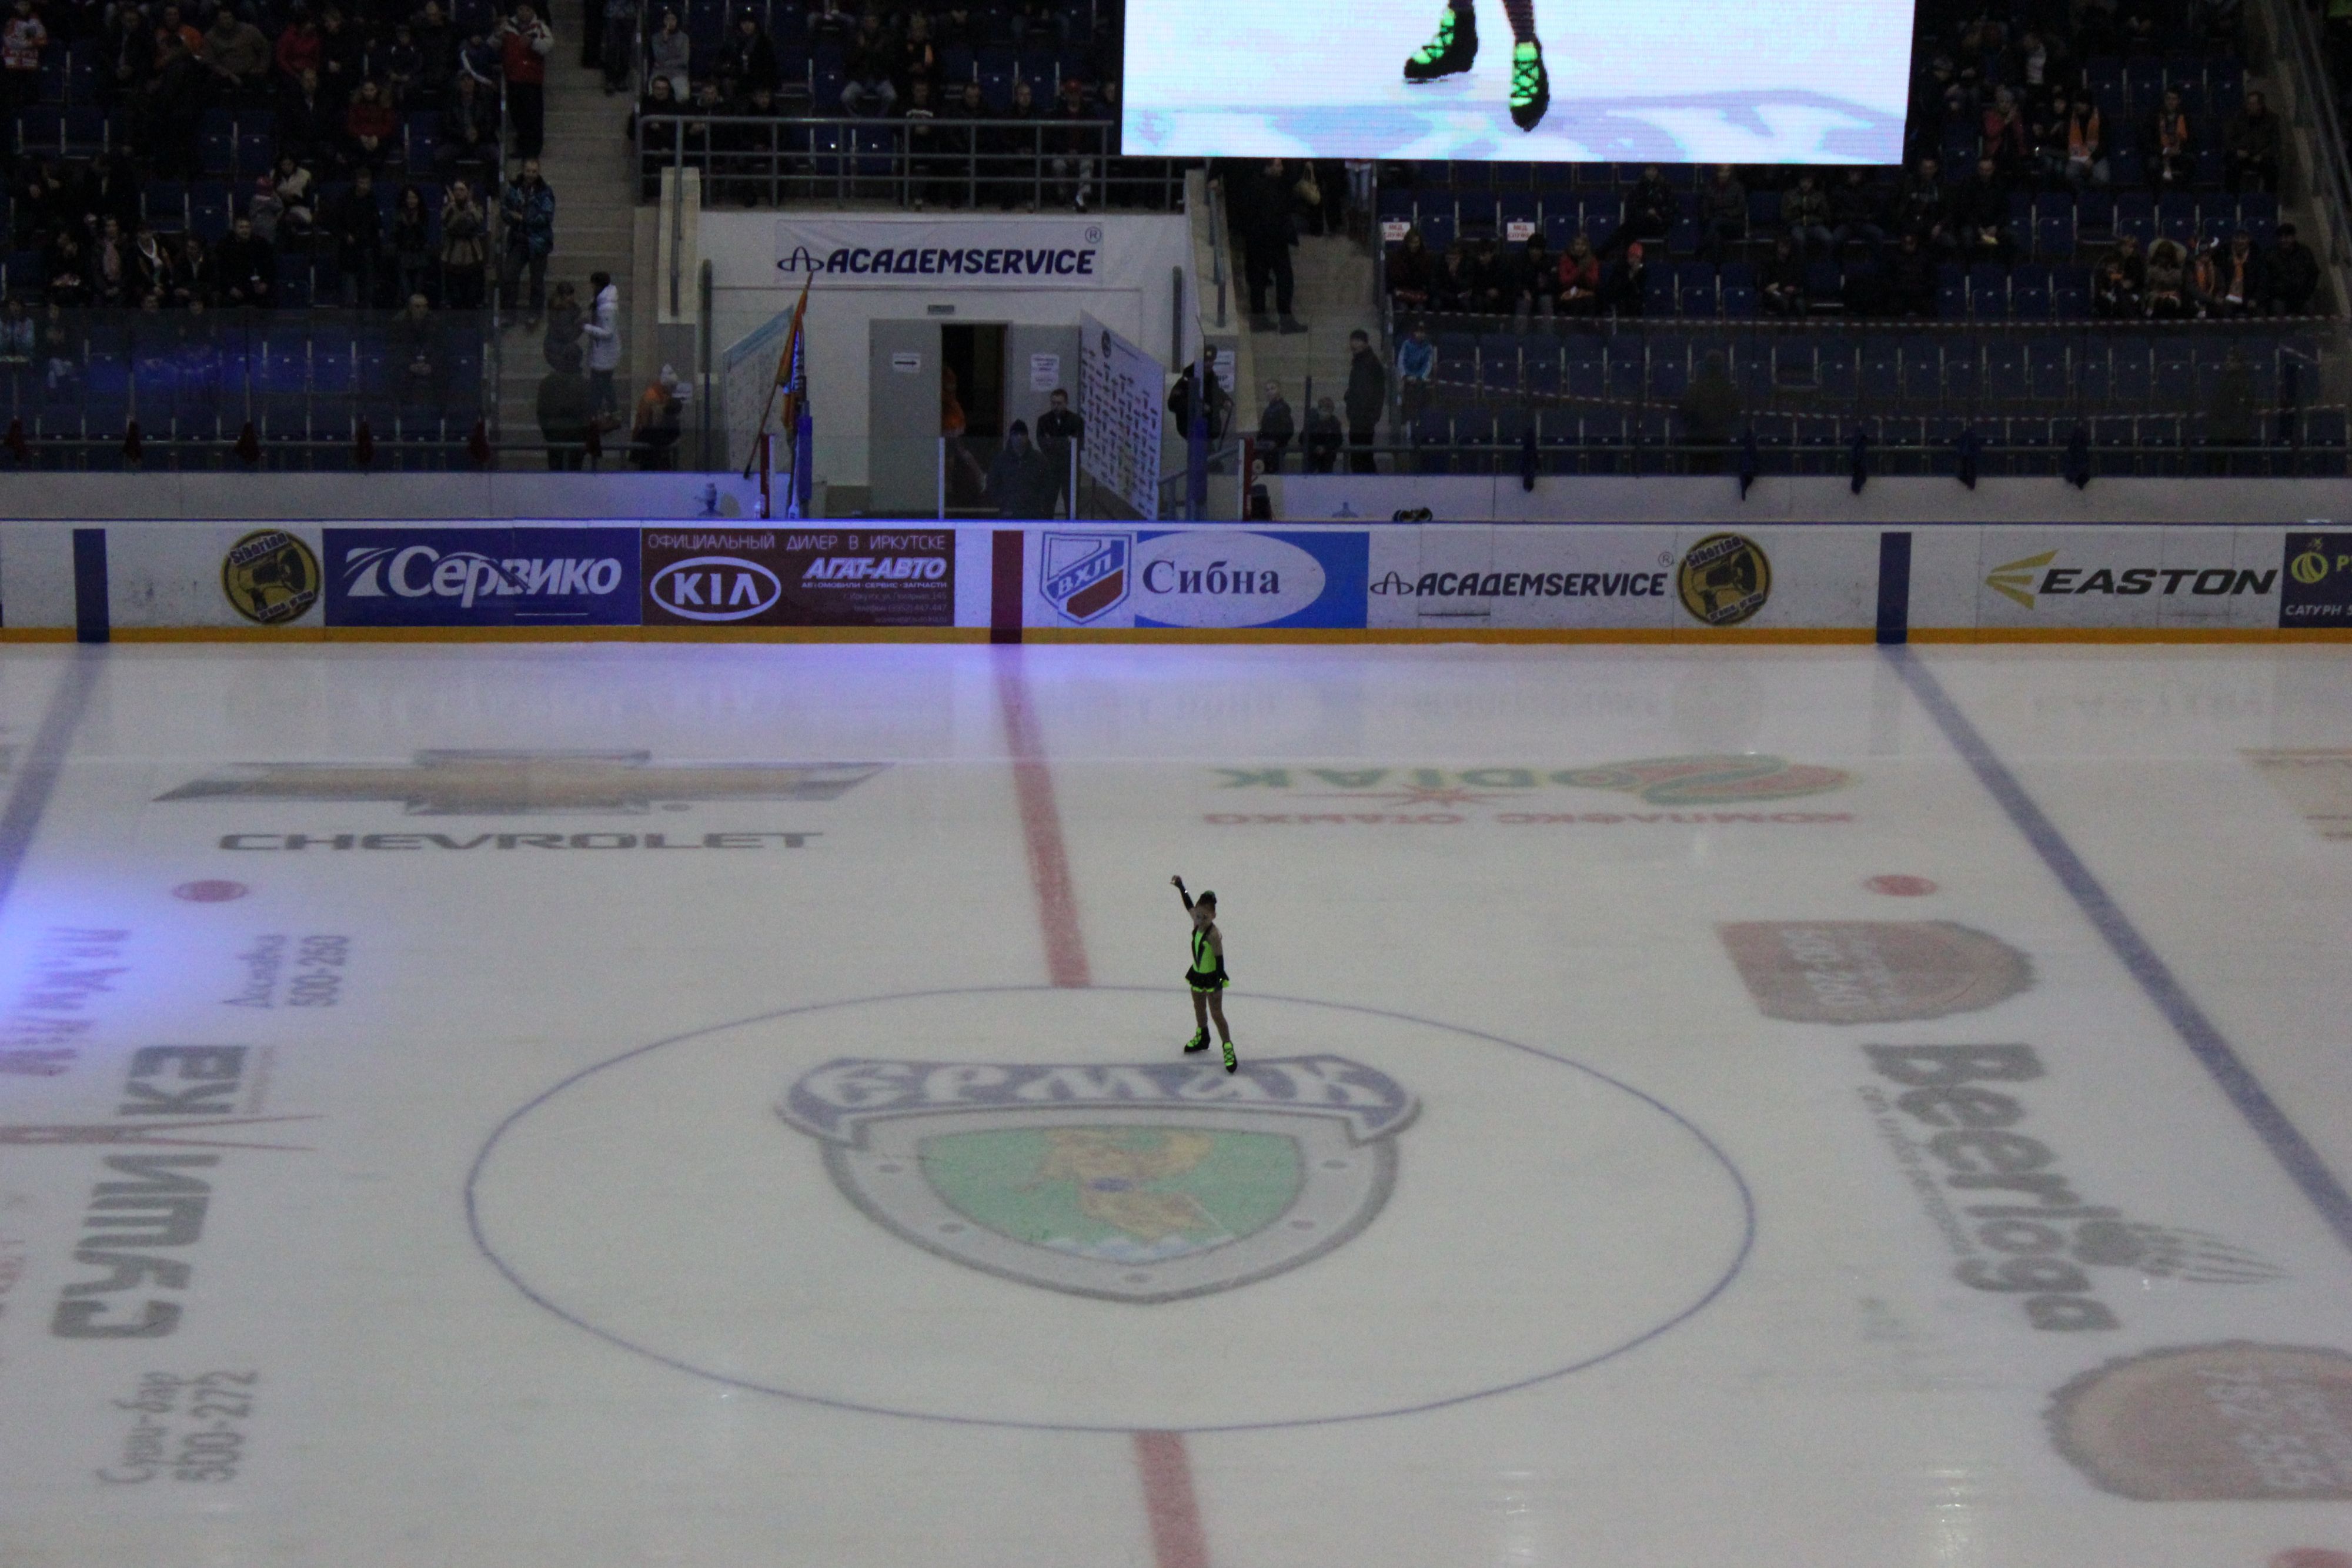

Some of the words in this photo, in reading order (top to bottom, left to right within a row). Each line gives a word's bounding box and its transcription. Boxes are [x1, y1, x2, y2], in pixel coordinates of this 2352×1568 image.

[649, 533, 775, 550] ОФИЦИАЛЬНЫЙ
[786, 535, 838, 551] ДИЛЕР
[849, 536, 858, 550] В
[870, 535, 946, 550] ИРКУТСКЕ
[801, 557, 948, 580] АГАТ-АВТО
[1058, 553, 1112, 595] ВХЛ
[1142, 560, 1280, 594] Сибна
[673, 573, 760, 605] KIA
[2039, 569, 2278, 595] EASTON
[2285, 604, 2343, 616] САТУРН
[218, 832, 824, 851] CHEVROLET
[1860, 1042, 2123, 1332] Beerloga
